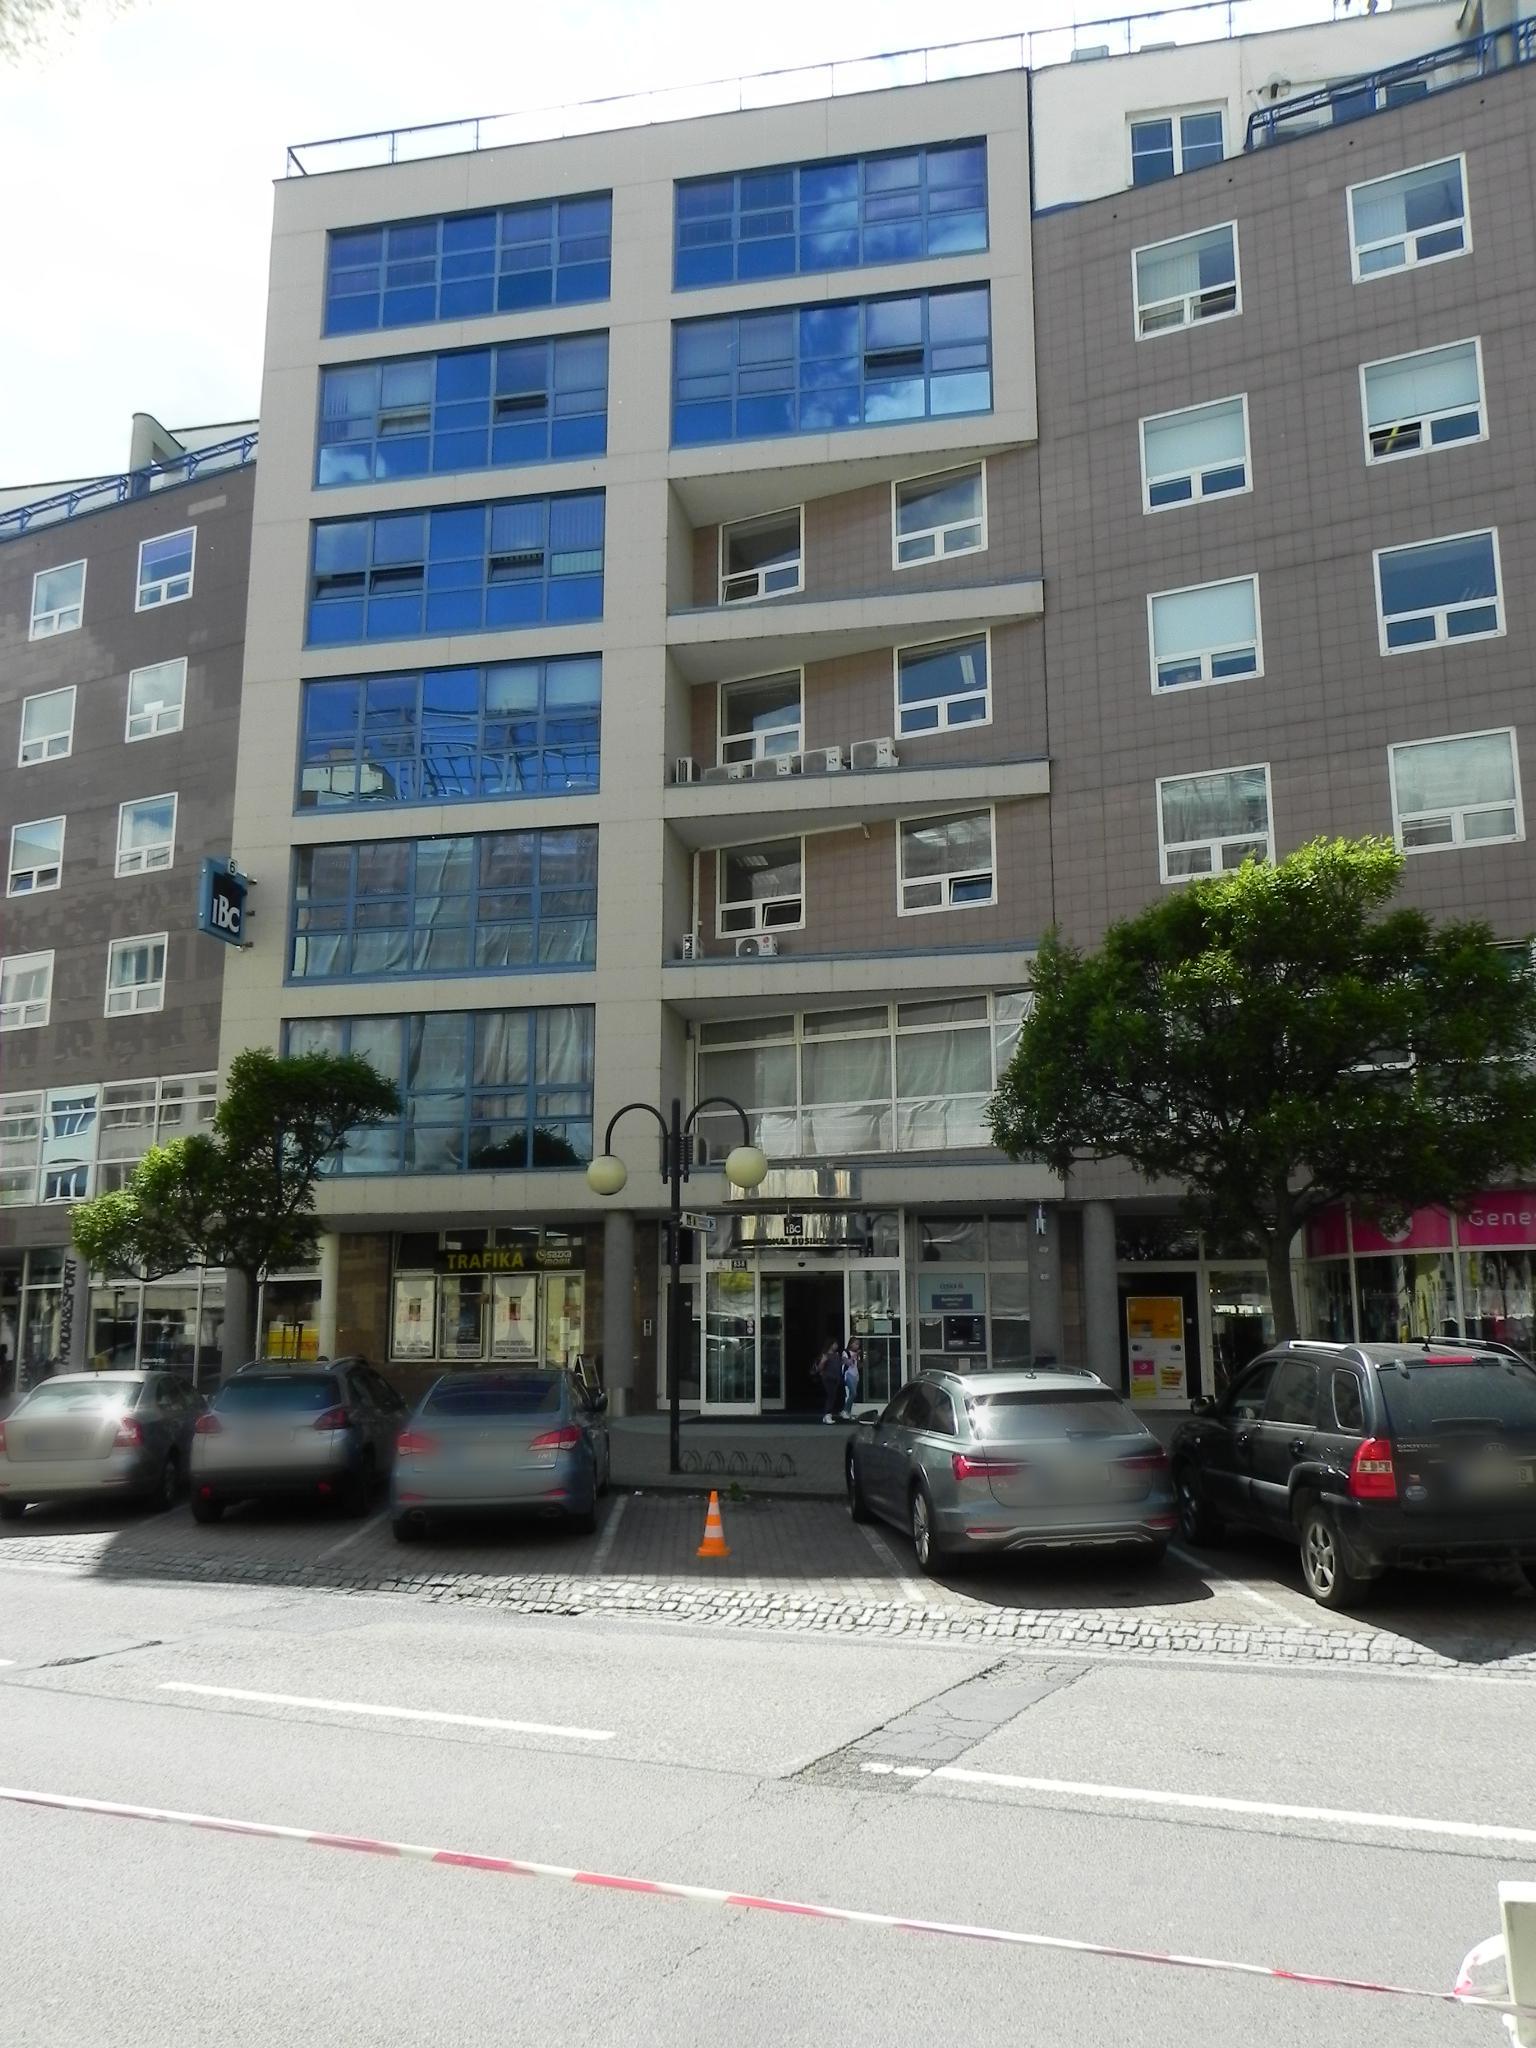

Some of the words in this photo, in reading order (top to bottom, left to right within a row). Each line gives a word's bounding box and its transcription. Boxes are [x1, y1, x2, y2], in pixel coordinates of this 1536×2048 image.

[229, 861, 236, 874] 6
[212, 894, 241, 933] IBC
[447, 1252, 524, 1269] TRAFIKA
